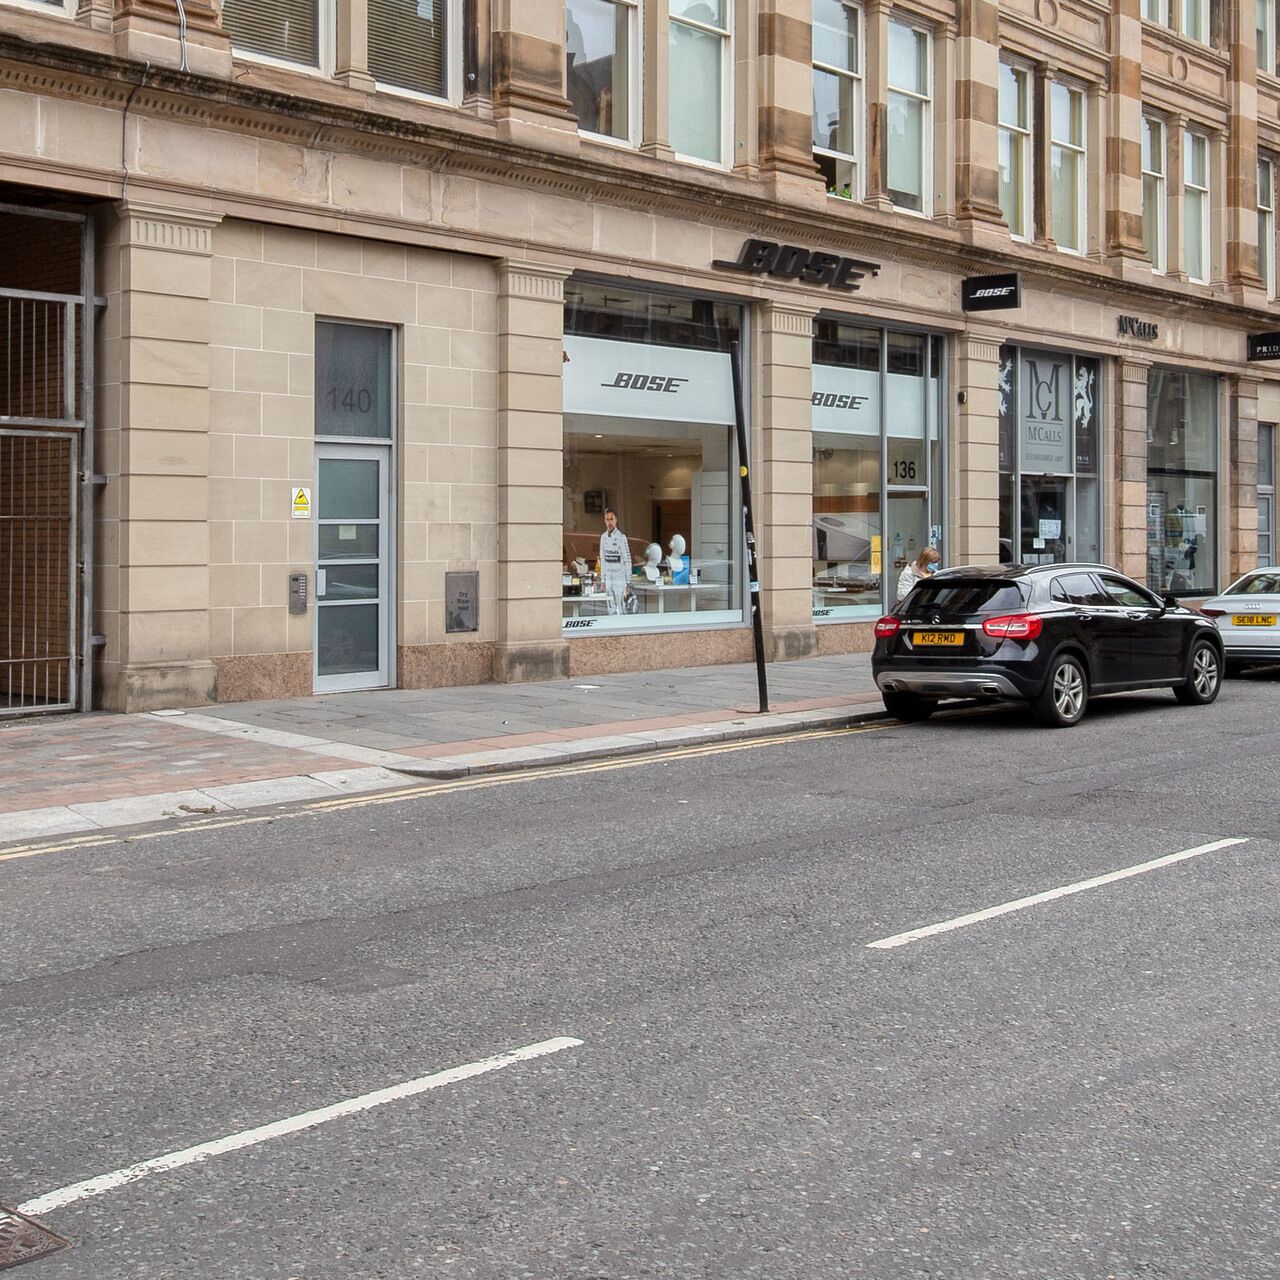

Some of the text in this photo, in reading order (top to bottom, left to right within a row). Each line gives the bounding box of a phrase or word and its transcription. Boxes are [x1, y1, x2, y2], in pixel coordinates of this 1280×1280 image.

[711, 238, 881, 292] BOSE
[969, 286, 1016, 298] BOSE
[601, 372, 689, 393] BOSE
[327, 387, 371, 414] 140
[811, 392, 869, 410] BOSE
[893, 461, 916, 479] 136
[563, 619, 598, 629] BOSE
[1237, 616, 1272, 625] SE18 LNC
[922, 632, 956, 644] K12 RMD
